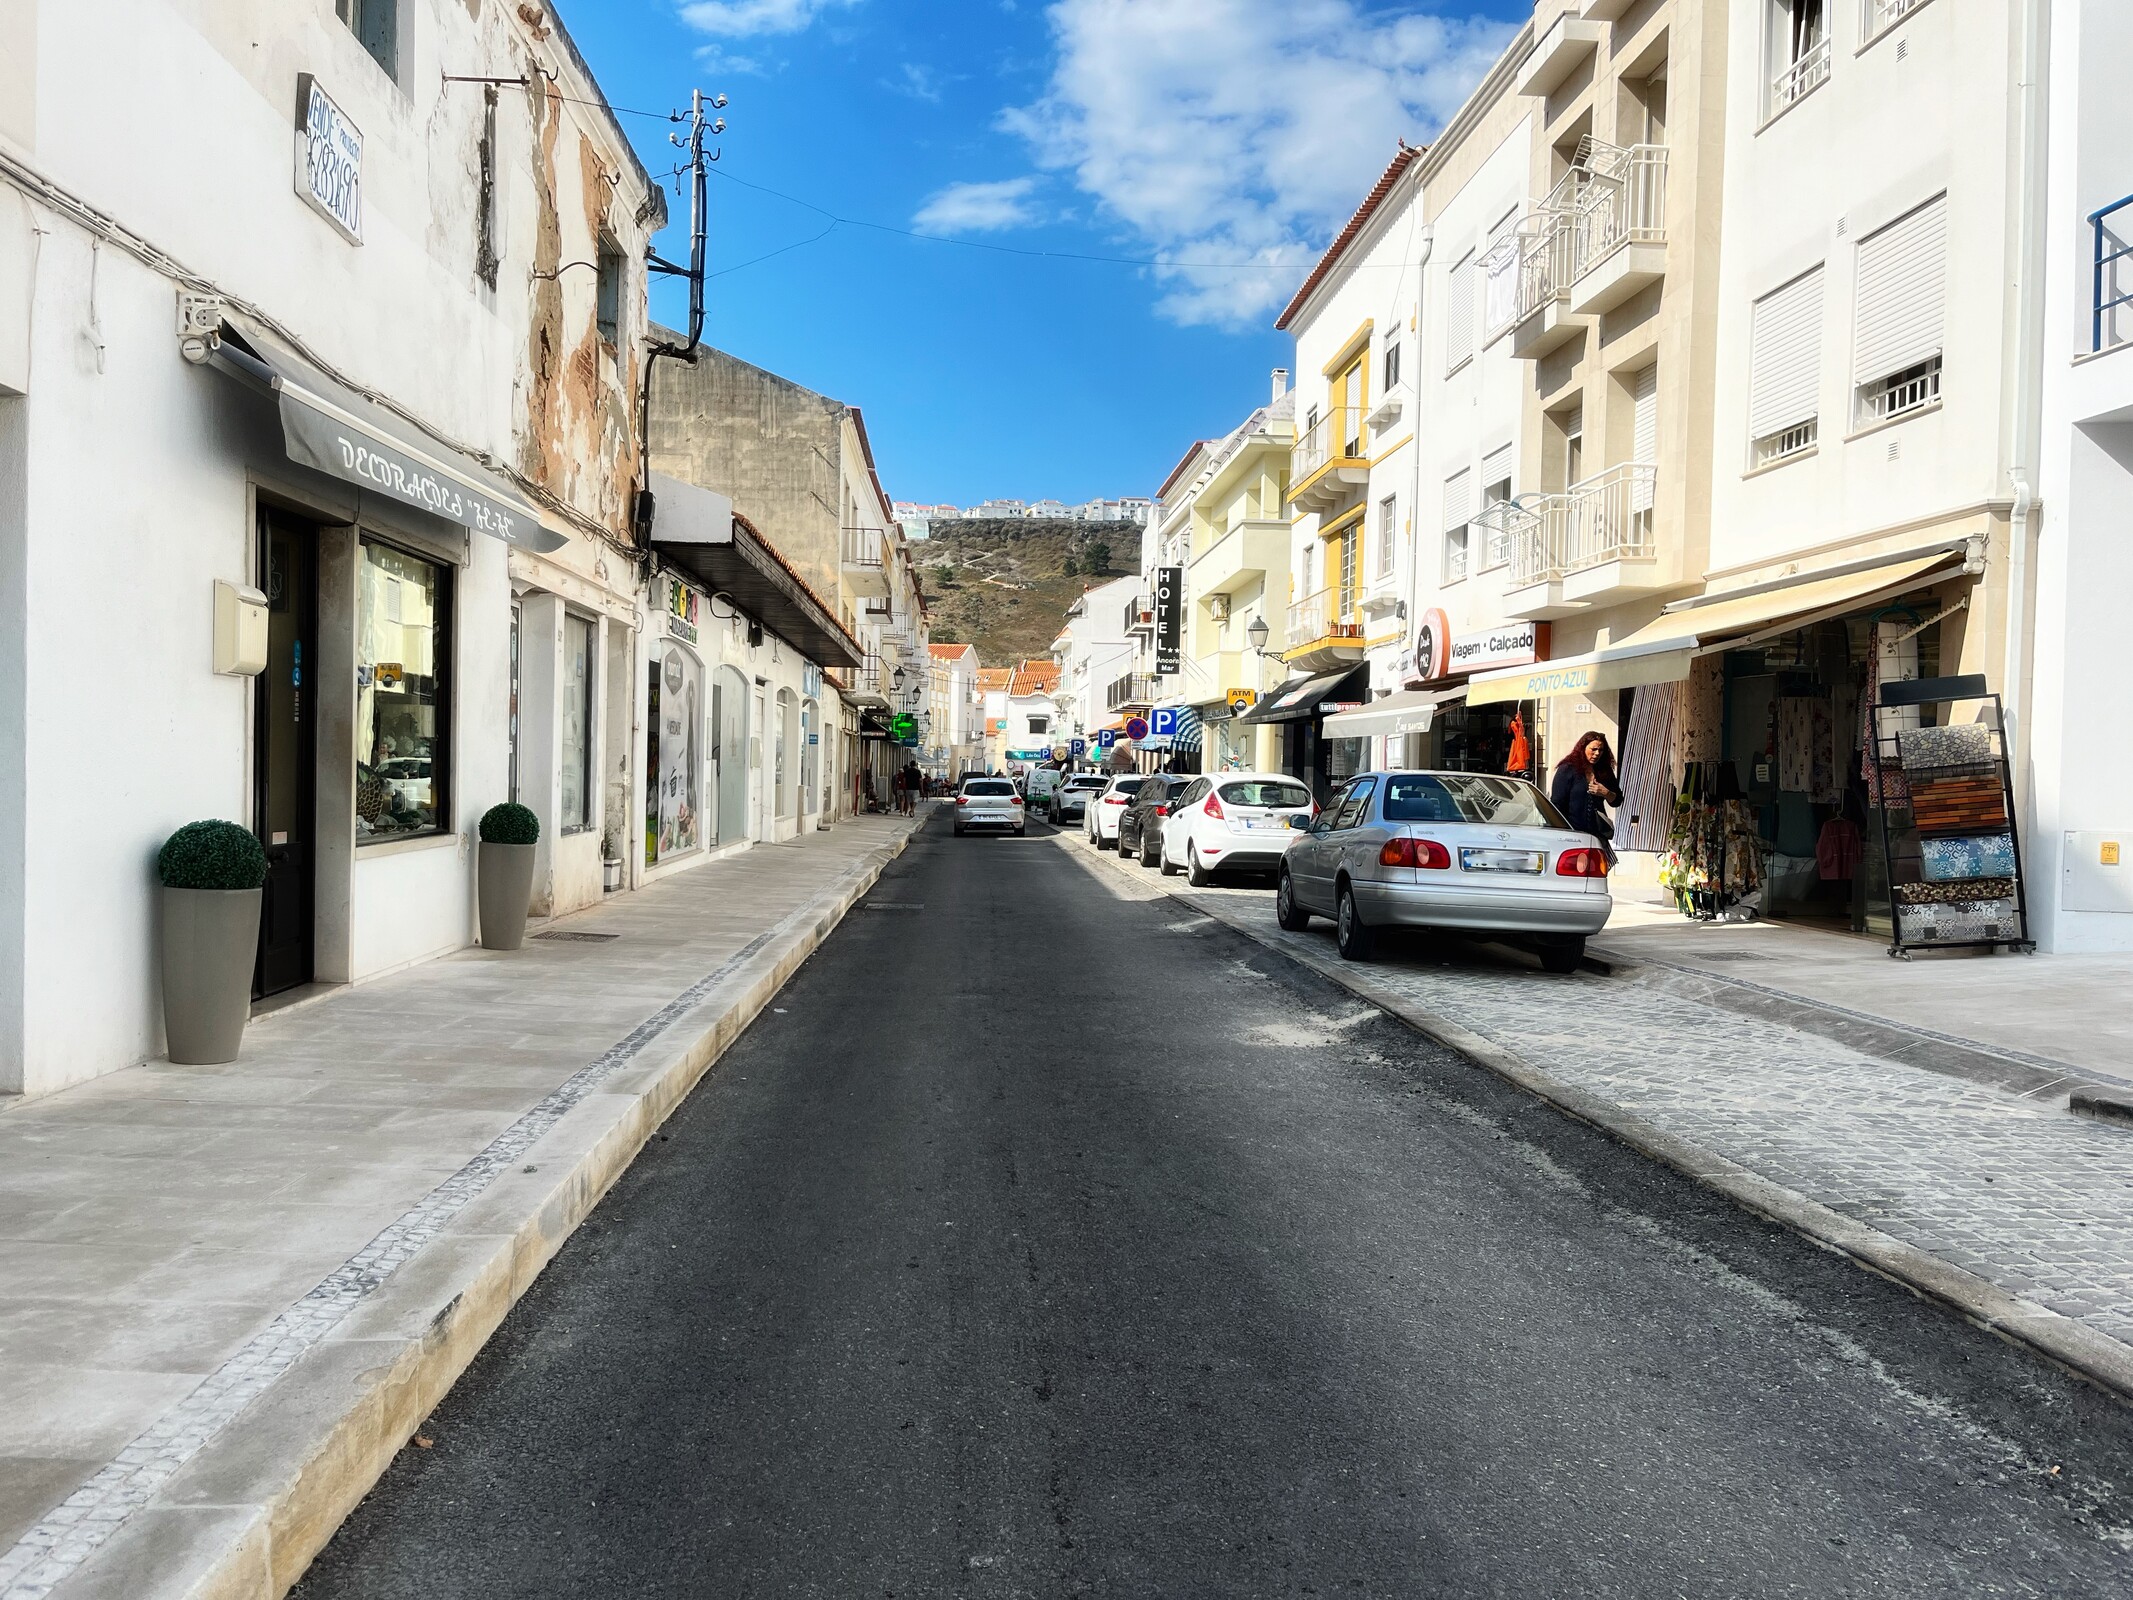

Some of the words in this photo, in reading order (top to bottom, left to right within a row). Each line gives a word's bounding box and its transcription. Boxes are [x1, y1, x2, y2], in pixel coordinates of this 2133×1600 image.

[308, 90, 335, 147] VENDE
[1158, 570, 1171, 651] HOTEL
[1451, 642, 1480, 659] Viagem
[1489, 632, 1533, 653] Calçado
[1527, 674, 1561, 694] PONTO
[1562, 670, 1589, 688] AZUL
[1156, 711, 1172, 733] P
[1073, 743, 1082, 754] P
[1101, 731, 1112, 746] P
[1042, 749, 1049, 758] P
